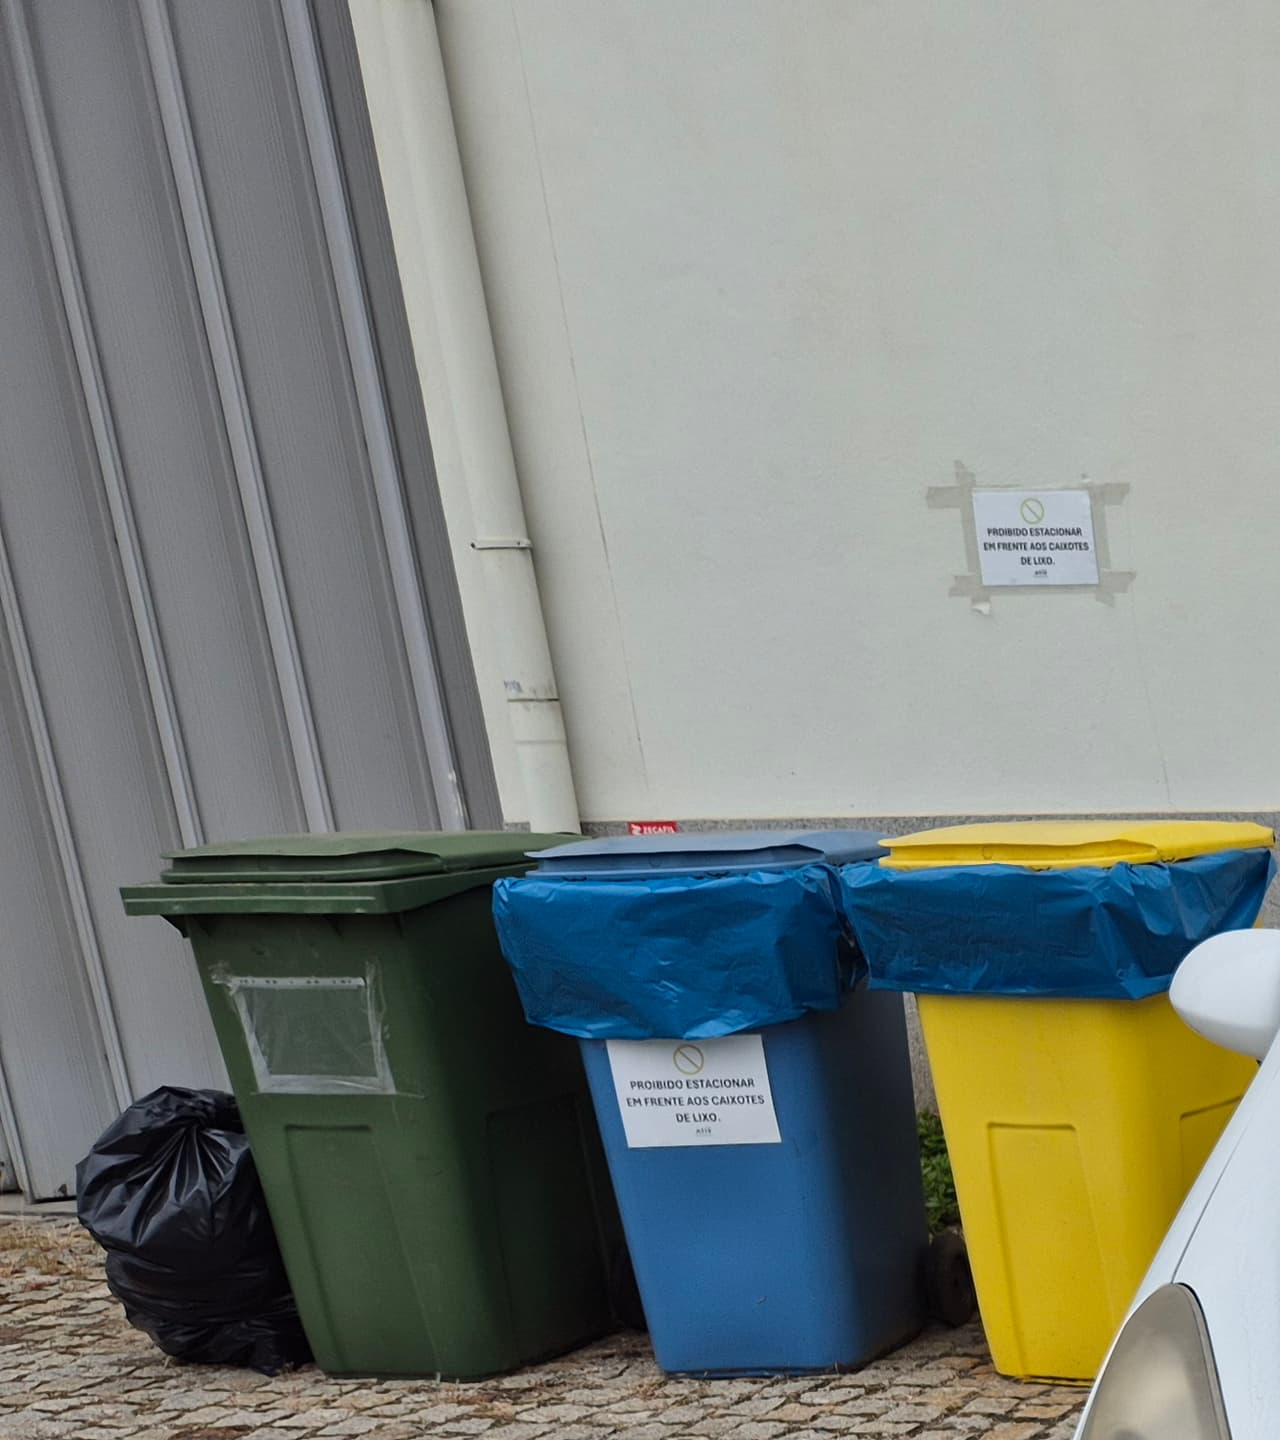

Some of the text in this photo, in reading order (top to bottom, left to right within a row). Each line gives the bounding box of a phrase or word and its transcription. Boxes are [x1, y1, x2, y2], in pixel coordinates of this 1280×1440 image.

[987, 527, 1082, 537] PROIBIDO ESTACIONAR
[983, 541, 1090, 551] EM FRENTE AOS CAIXOTES
[1020, 556, 1056, 566] DE LIXO.
[630, 1078, 755, 1090] PROIBIDO ESTACIONAR
[626, 1095, 765, 1107] EM FRENTE AOS CAIXOTES
[676, 1112, 721, 1123] DE LIXO.
